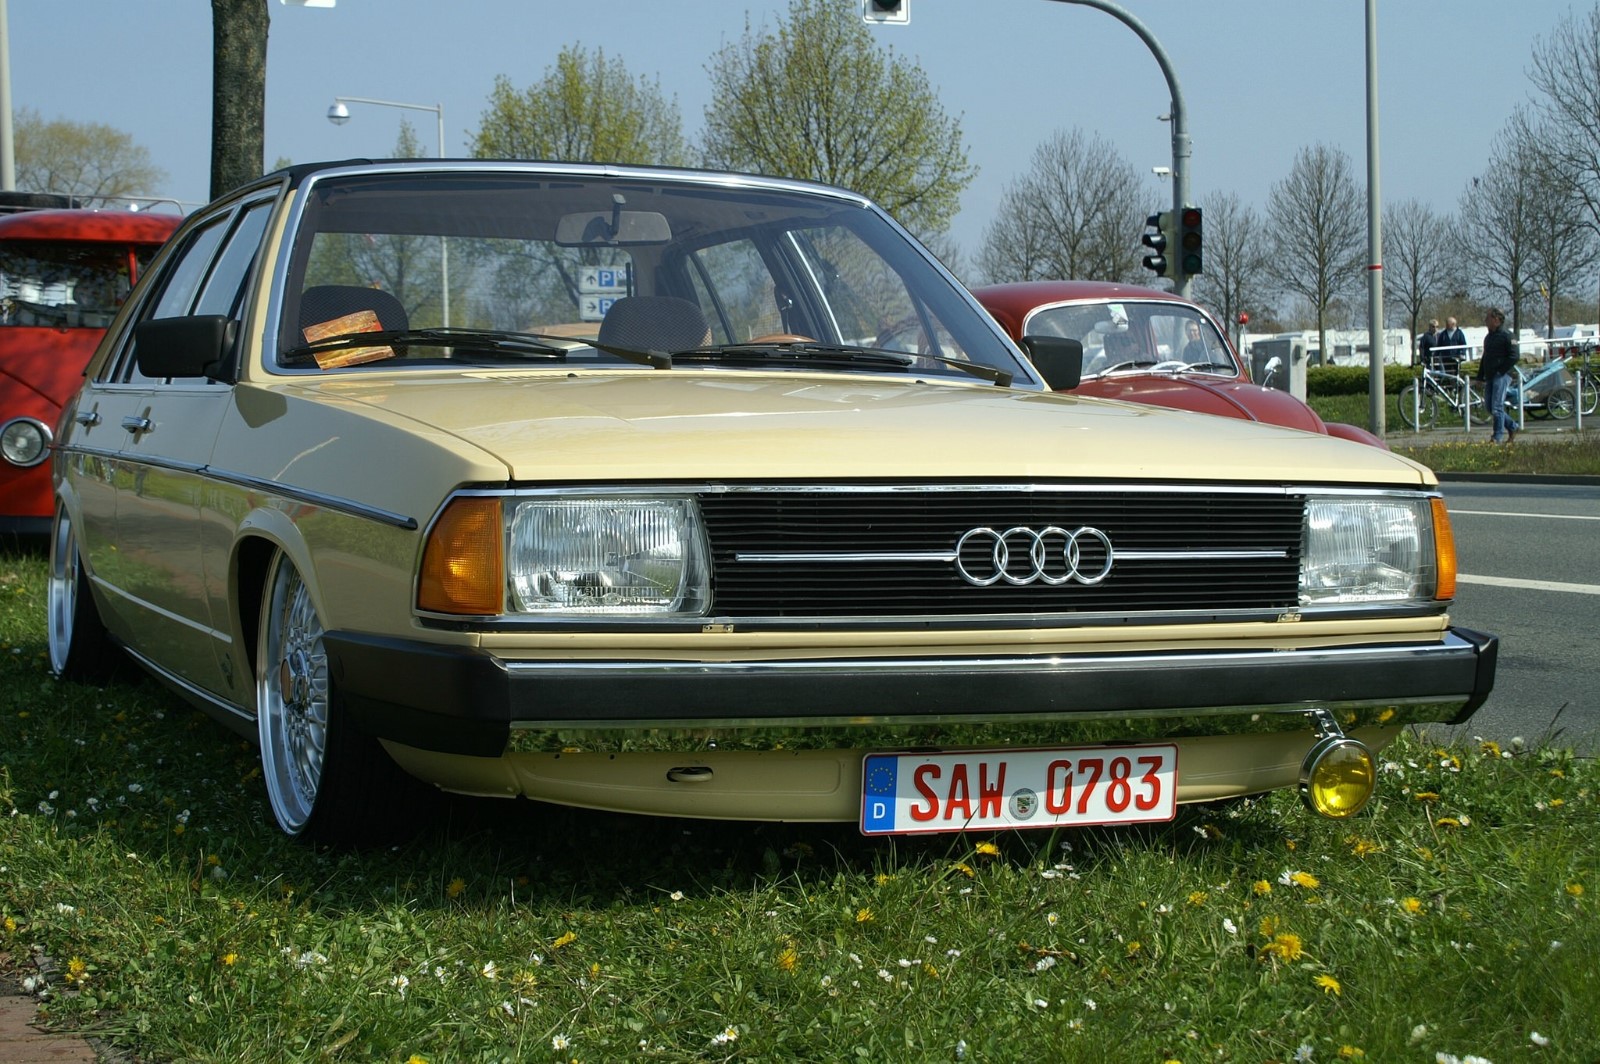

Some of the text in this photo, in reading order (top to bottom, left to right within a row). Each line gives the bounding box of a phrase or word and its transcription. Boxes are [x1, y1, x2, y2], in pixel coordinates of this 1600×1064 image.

[602, 271, 611, 285] P
[602, 300, 611, 313] P
[910, 762, 1007, 821] SAW
[1045, 755, 1162, 815] 0783
[873, 803, 886, 819] D
